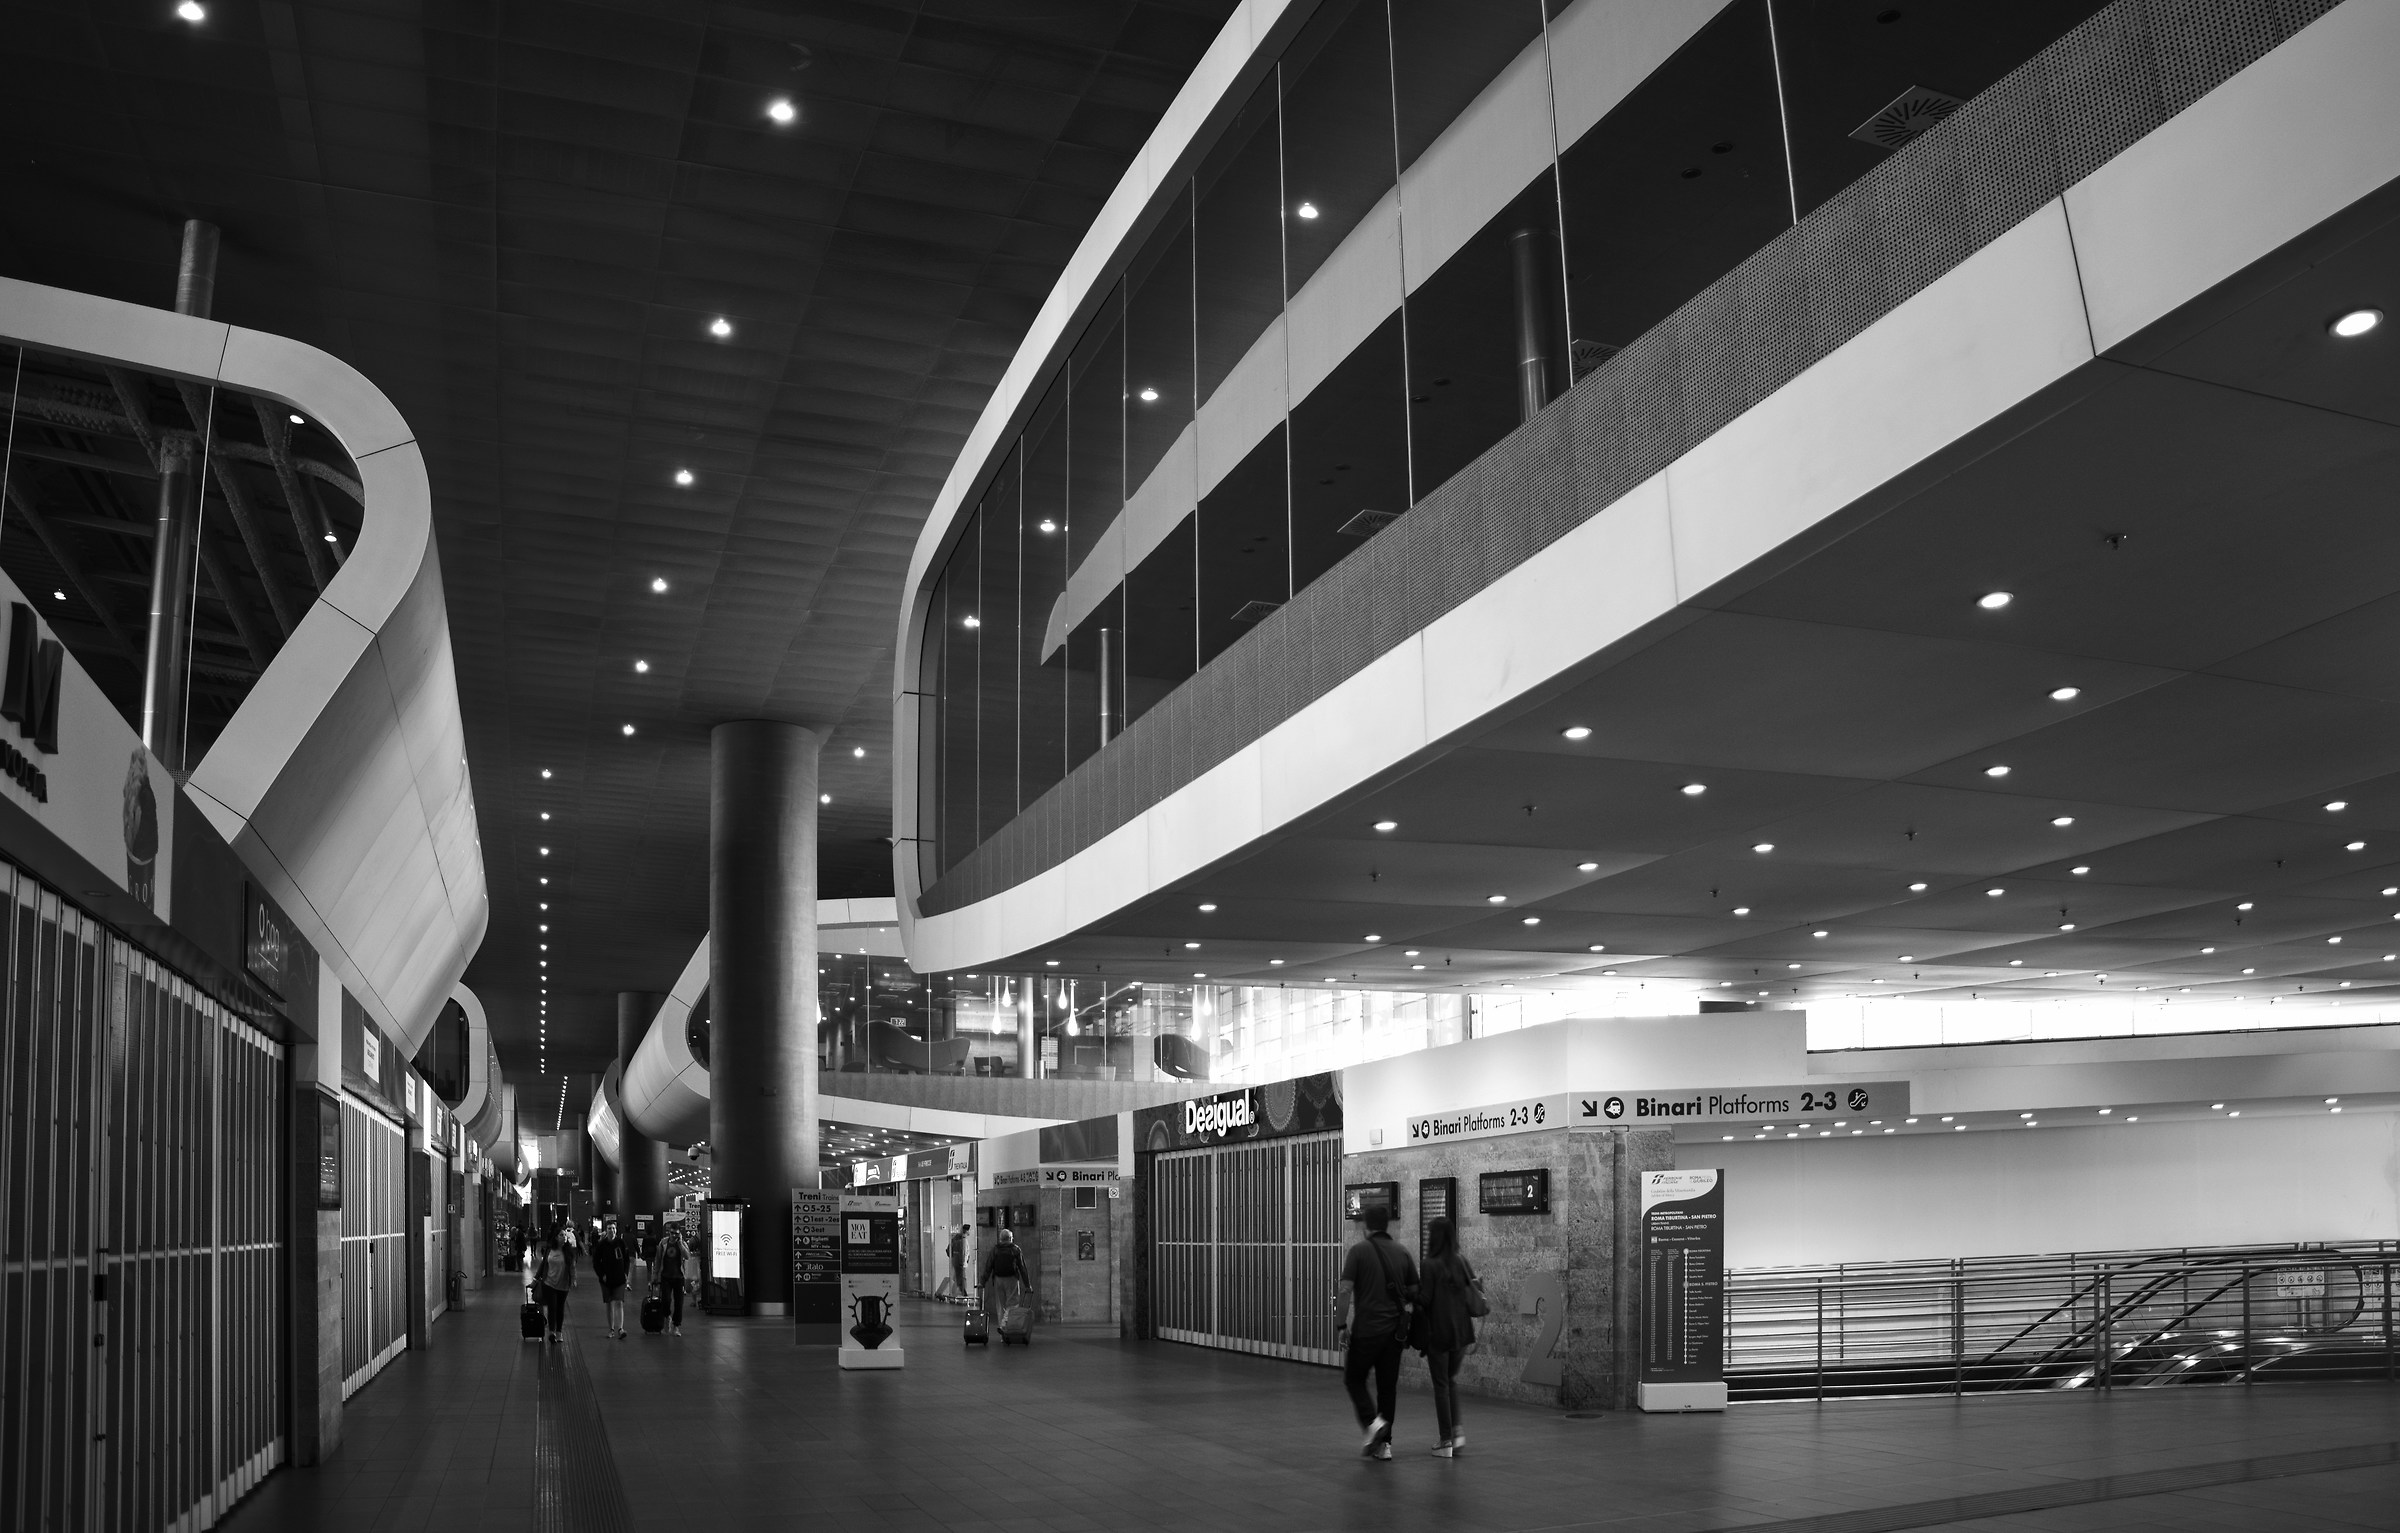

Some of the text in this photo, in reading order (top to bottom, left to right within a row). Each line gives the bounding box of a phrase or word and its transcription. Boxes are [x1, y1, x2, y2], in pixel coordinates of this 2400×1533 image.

[259, 903, 266, 939] O
[266, 909, 280, 962] bag
[1636, 1091, 1838, 1118] Binari Platforms 2-3
[1185, 1088, 1250, 1137] Desigual
[1433, 1106, 1529, 1137] Binari Platforms 2-3
[1072, 1170, 1105, 1181] Binari
[798, 1191, 821, 1201] Treni
[1527, 1184, 1534, 1198] 2
[810, 1204, 832, 1214] 5-25
[811, 1226, 825, 1234] 3est
[851, 1223, 867, 1232] MOV
[851, 1231, 867, 1240] EAT
